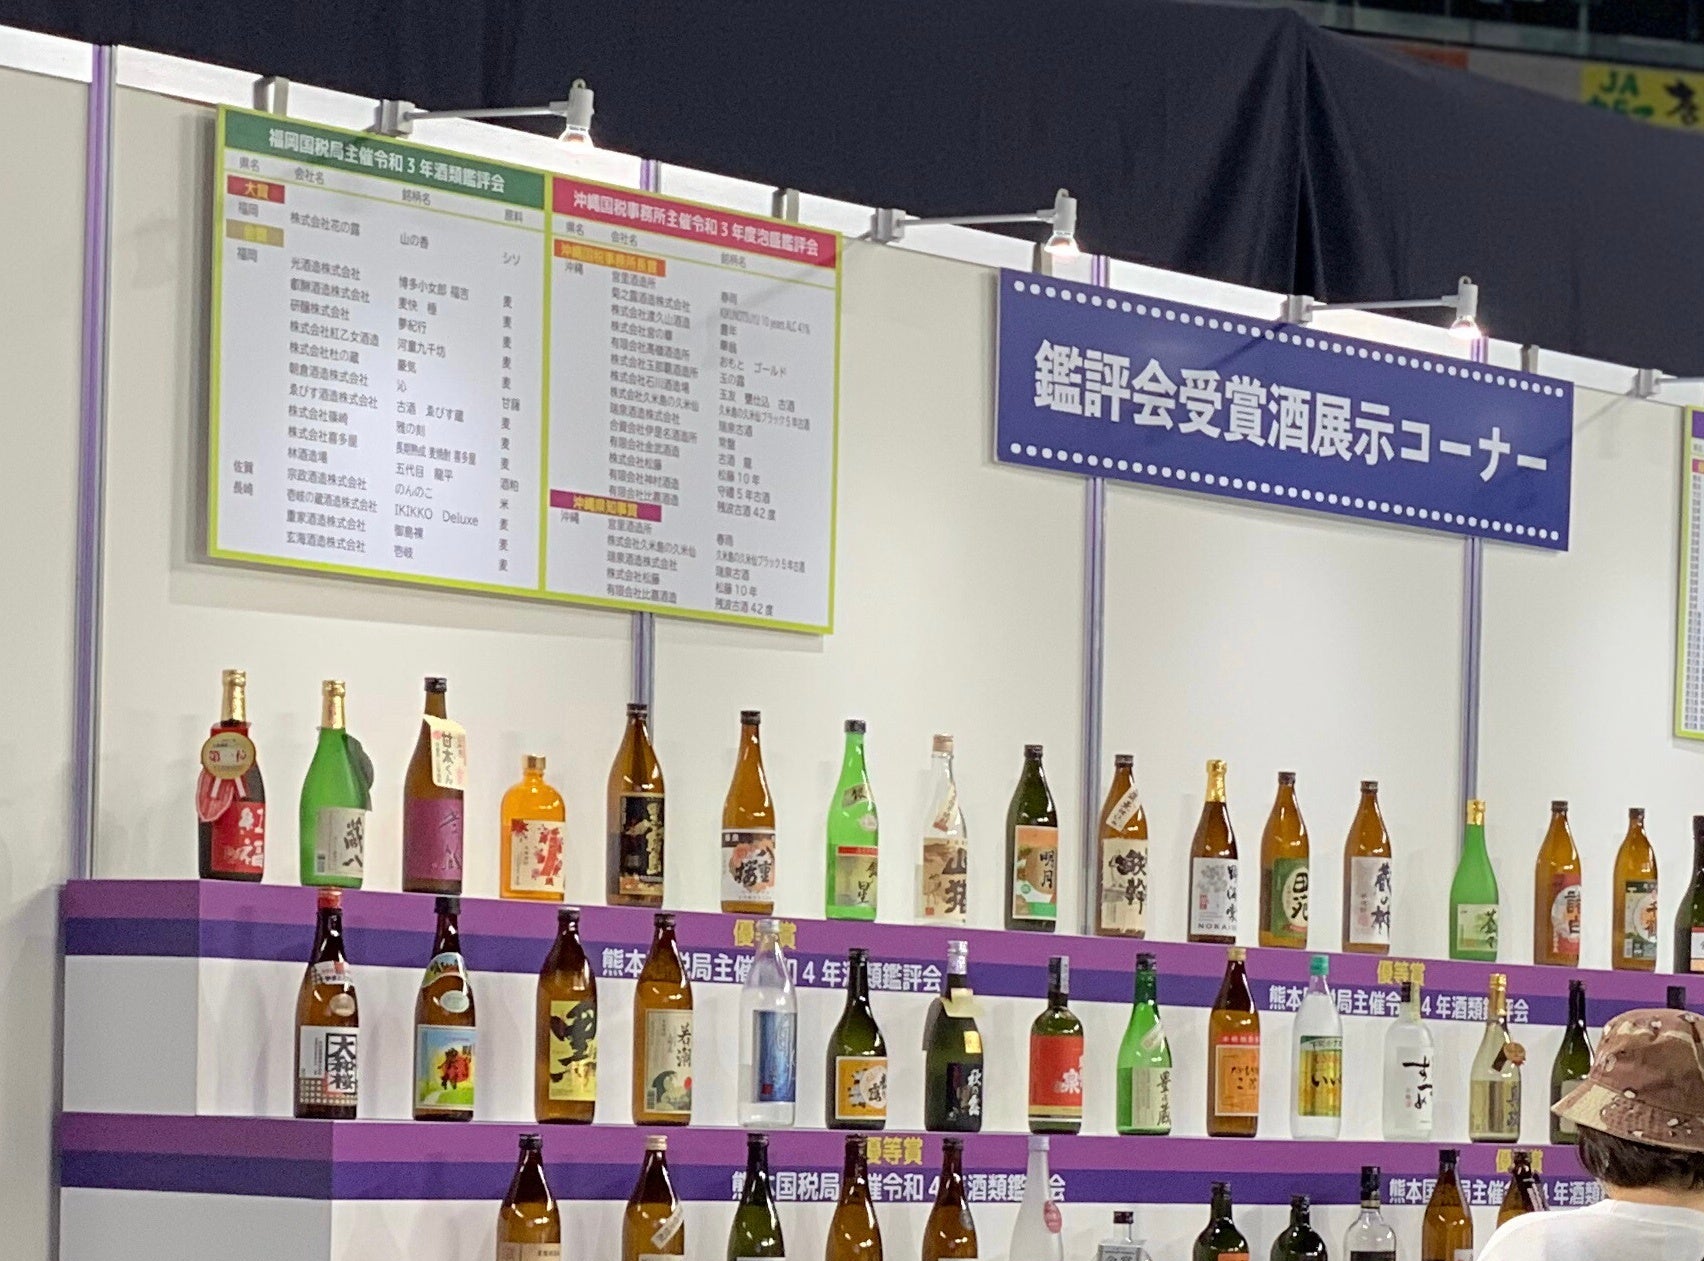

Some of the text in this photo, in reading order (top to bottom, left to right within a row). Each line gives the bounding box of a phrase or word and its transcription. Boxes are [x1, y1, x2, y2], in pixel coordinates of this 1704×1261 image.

[1600, 70, 1640, 98] JA
[268, 127, 504, 193] 福岡国税局主催令和3年酒類鑑評会
[1032, 339, 1549, 483] 鑑評会受賞酒展示コーナー
[394, 503, 478, 526] IKIKKO Deluxe
[1040, 851, 1055, 889] 明月
[733, 919, 798, 950] 優賞
[1496, 1148, 1544, 1174] 優賞
